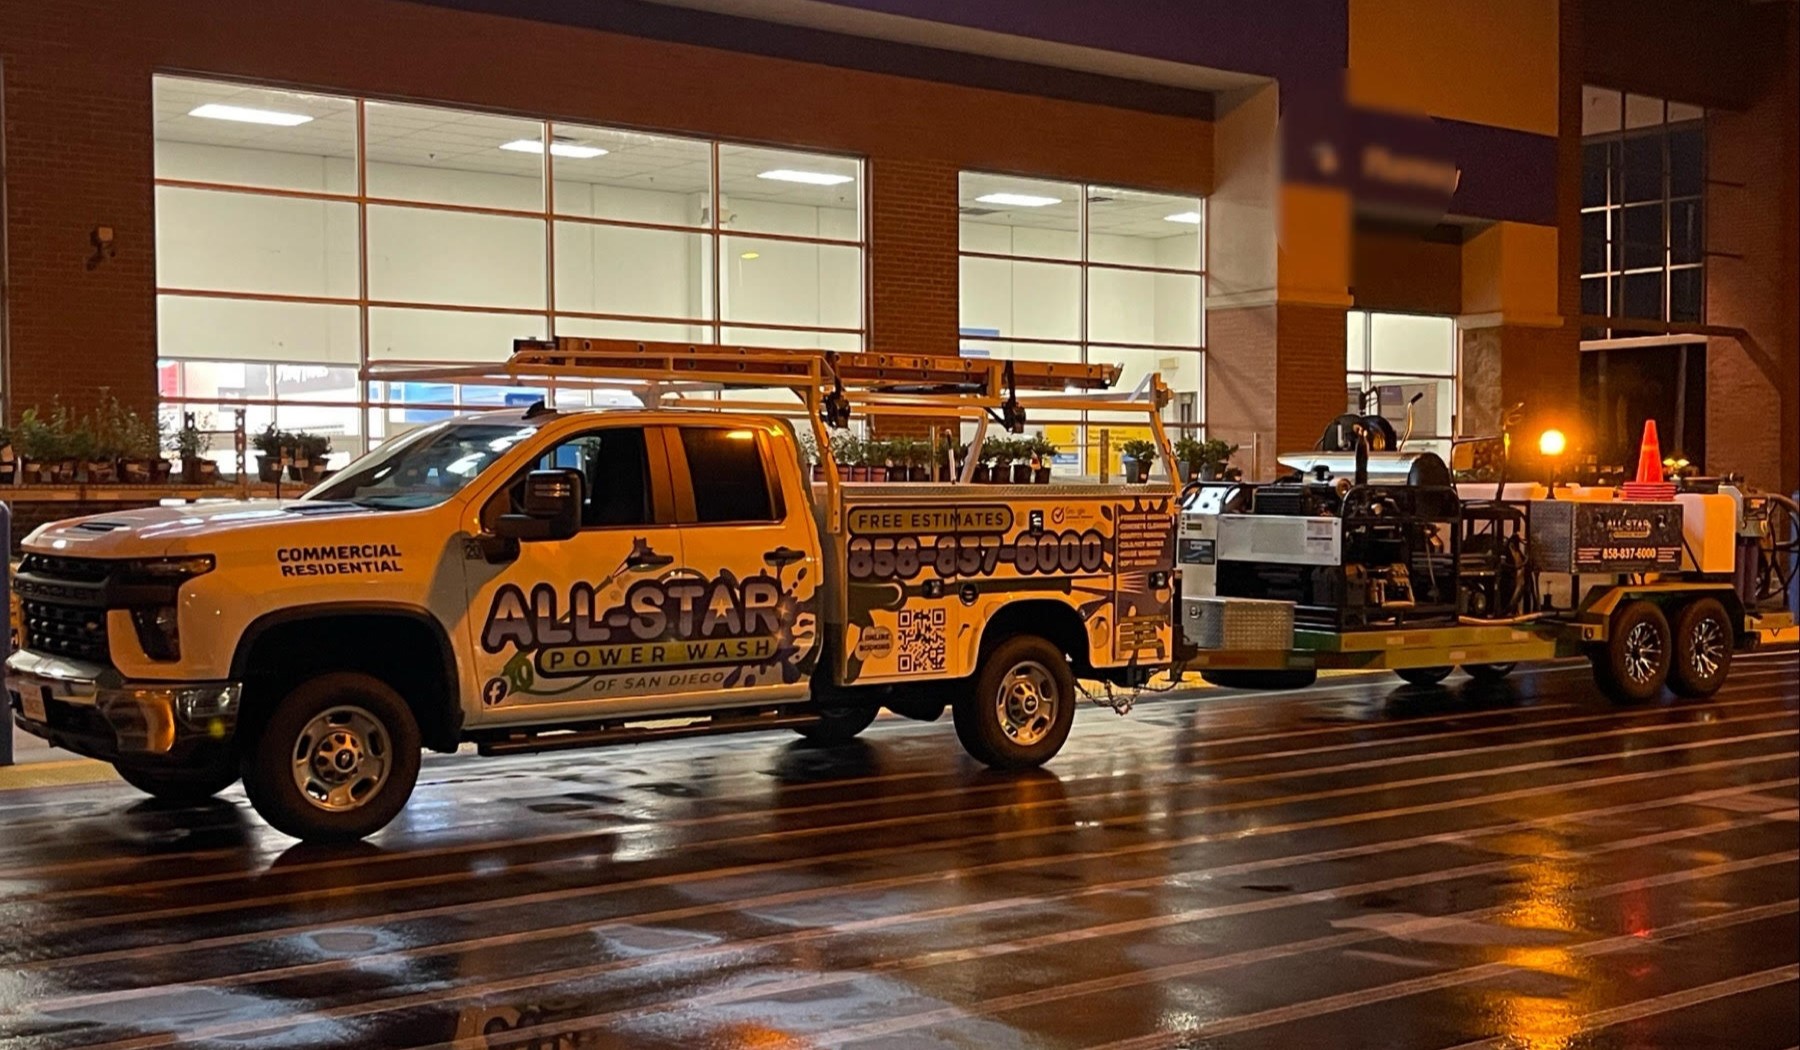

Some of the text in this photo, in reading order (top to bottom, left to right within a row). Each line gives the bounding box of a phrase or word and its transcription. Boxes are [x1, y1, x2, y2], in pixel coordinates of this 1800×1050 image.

[858, 511, 1004, 528] FREE ESTIMATES
[1606, 518, 1651, 531] ALL-STAR
[277, 544, 402, 562] COMMERCIAL
[848, 530, 1103, 579] 858-837-6000
[1602, 547, 1657, 560] 858-837-6000
[281, 560, 403, 577] RESIDENTIAL
[485, 581, 781, 649] ALL-STAR
[550, 639, 771, 668] POWER WASH
[593, 672, 725, 692] OF SAN DIEGO
